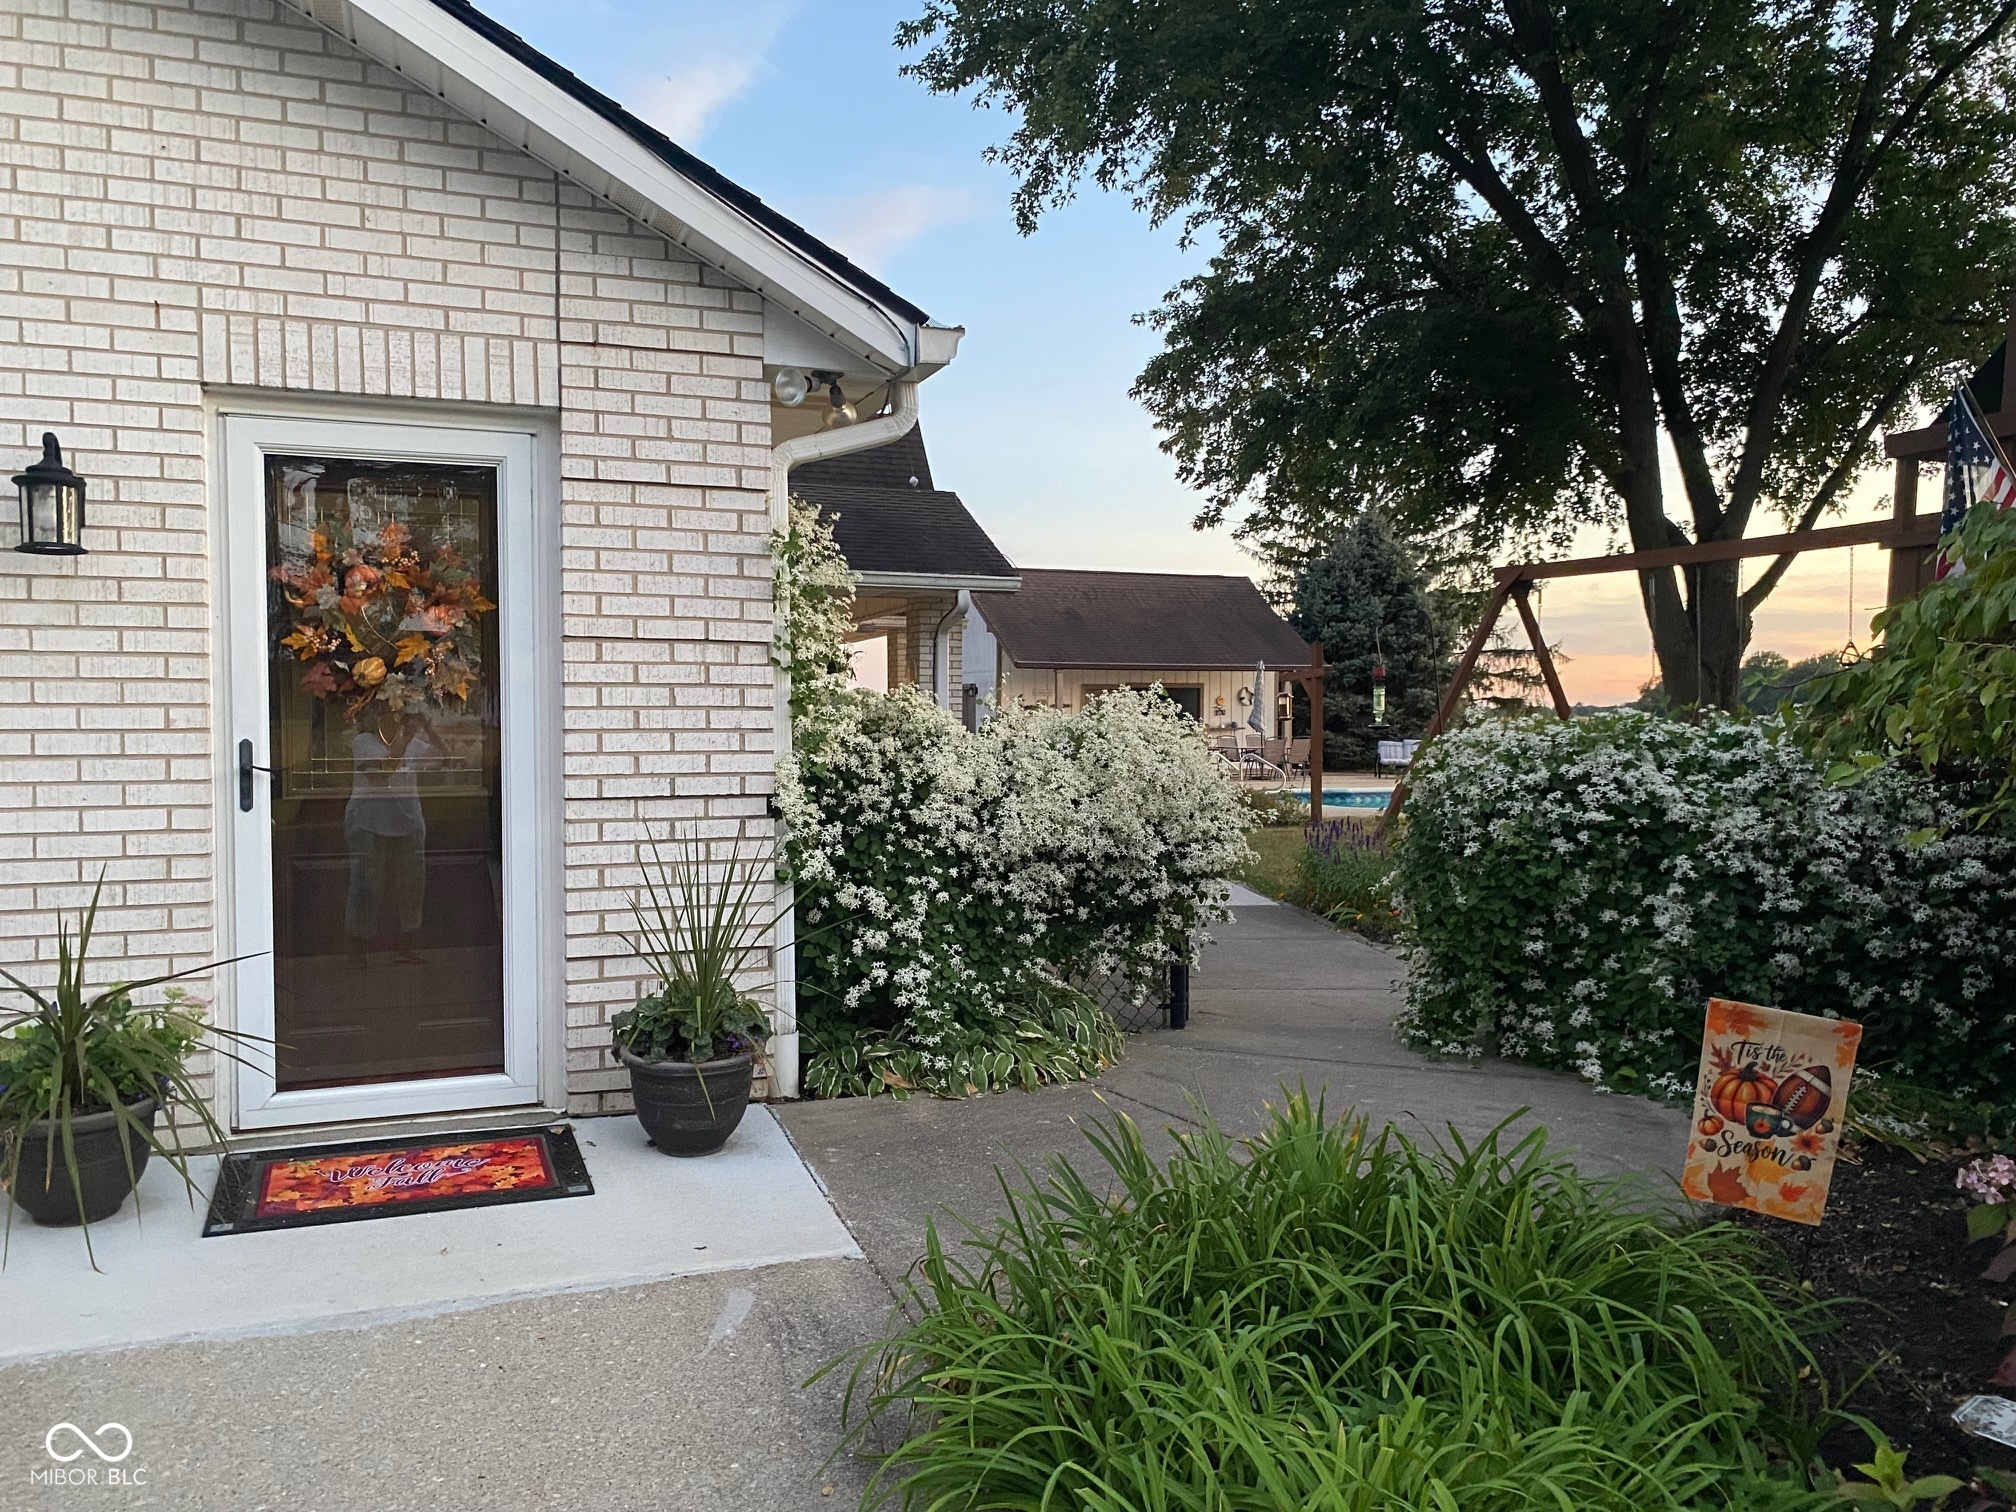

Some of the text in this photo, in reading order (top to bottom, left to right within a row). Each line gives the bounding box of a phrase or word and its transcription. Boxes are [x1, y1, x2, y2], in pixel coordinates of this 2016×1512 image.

[1764, 1045, 1788, 1063] the
[1717, 1129, 1794, 1167] Season
[316, 1157, 491, 1182] Welcome
[365, 1167, 472, 1191] Fall
